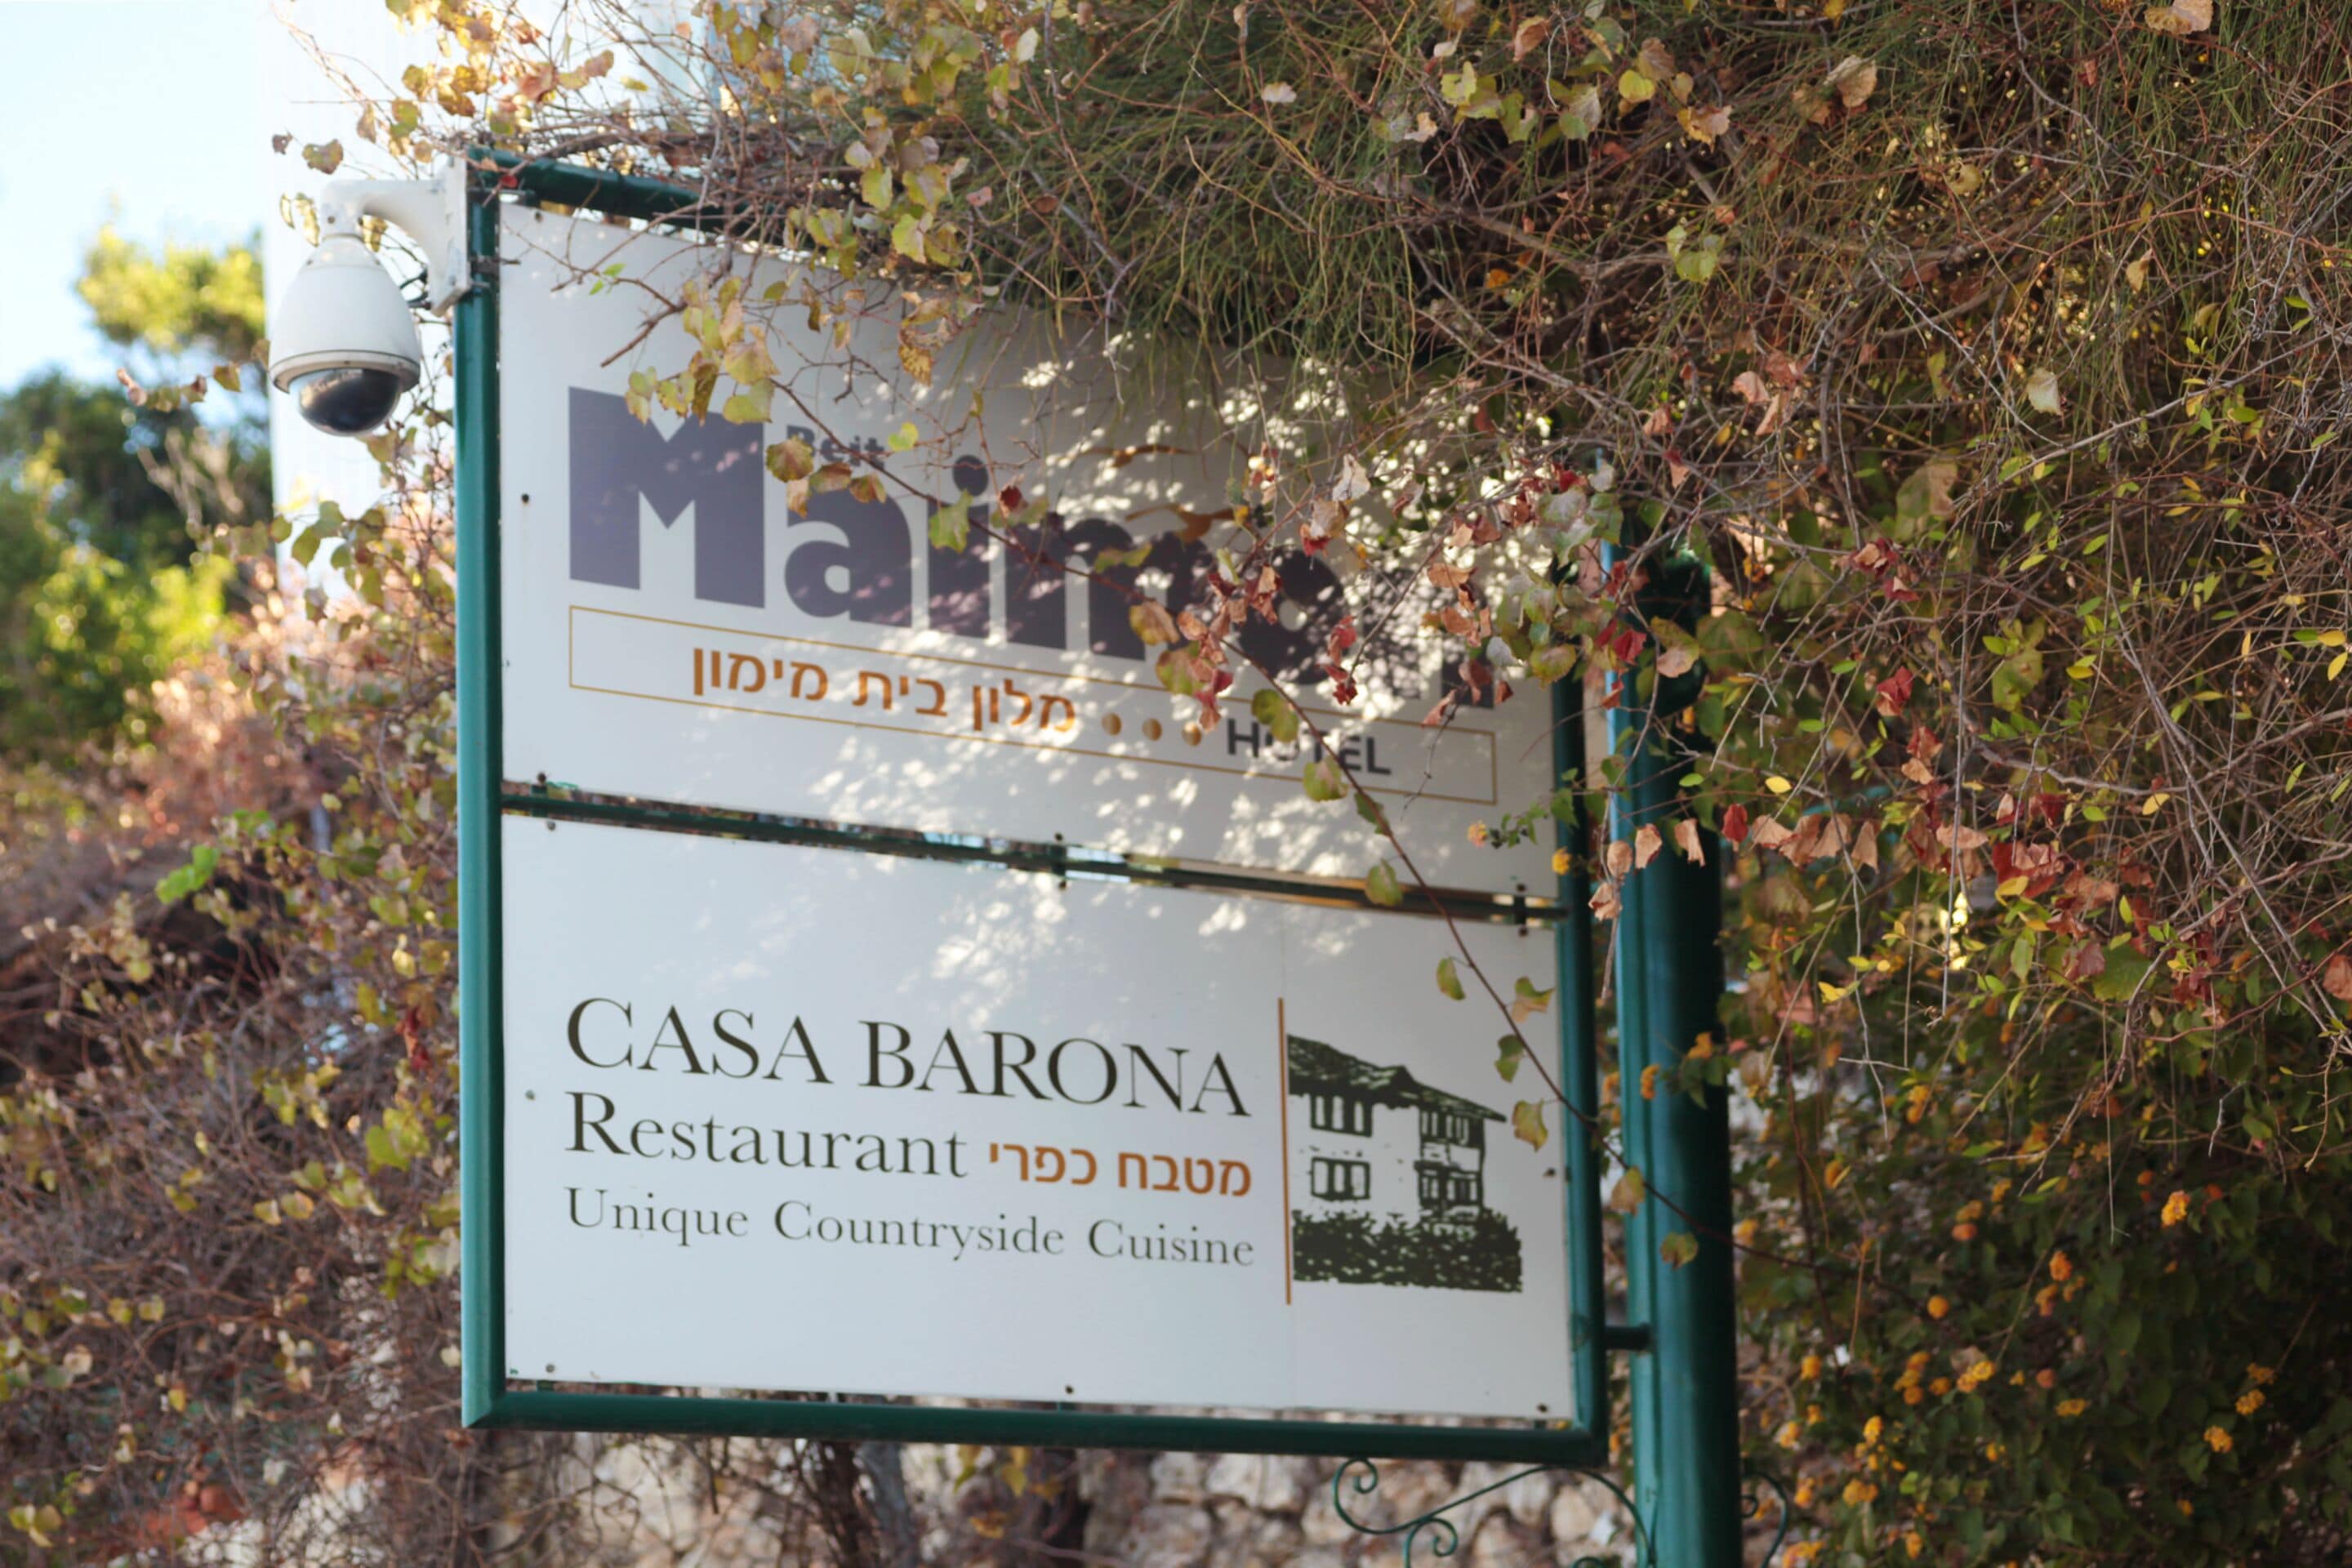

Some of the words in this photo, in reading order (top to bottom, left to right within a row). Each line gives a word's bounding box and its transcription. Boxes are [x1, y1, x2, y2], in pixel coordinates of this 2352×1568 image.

[693, 648, 830, 701] מימון
[853, 670, 949, 717] בית
[973, 679, 1077, 731] מלון
[568, 998, 834, 1085] CASA
[858, 1020, 1252, 1116] BARONA
[565, 1091, 967, 1178] Restaurant
[990, 1143, 1097, 1184] כפרי
[1118, 1152, 1250, 1196] מטבח
[565, 1187, 748, 1247] Unique
[774, 1200, 1064, 1261] Countryside
[1088, 1219, 1254, 1266] Cuisine
